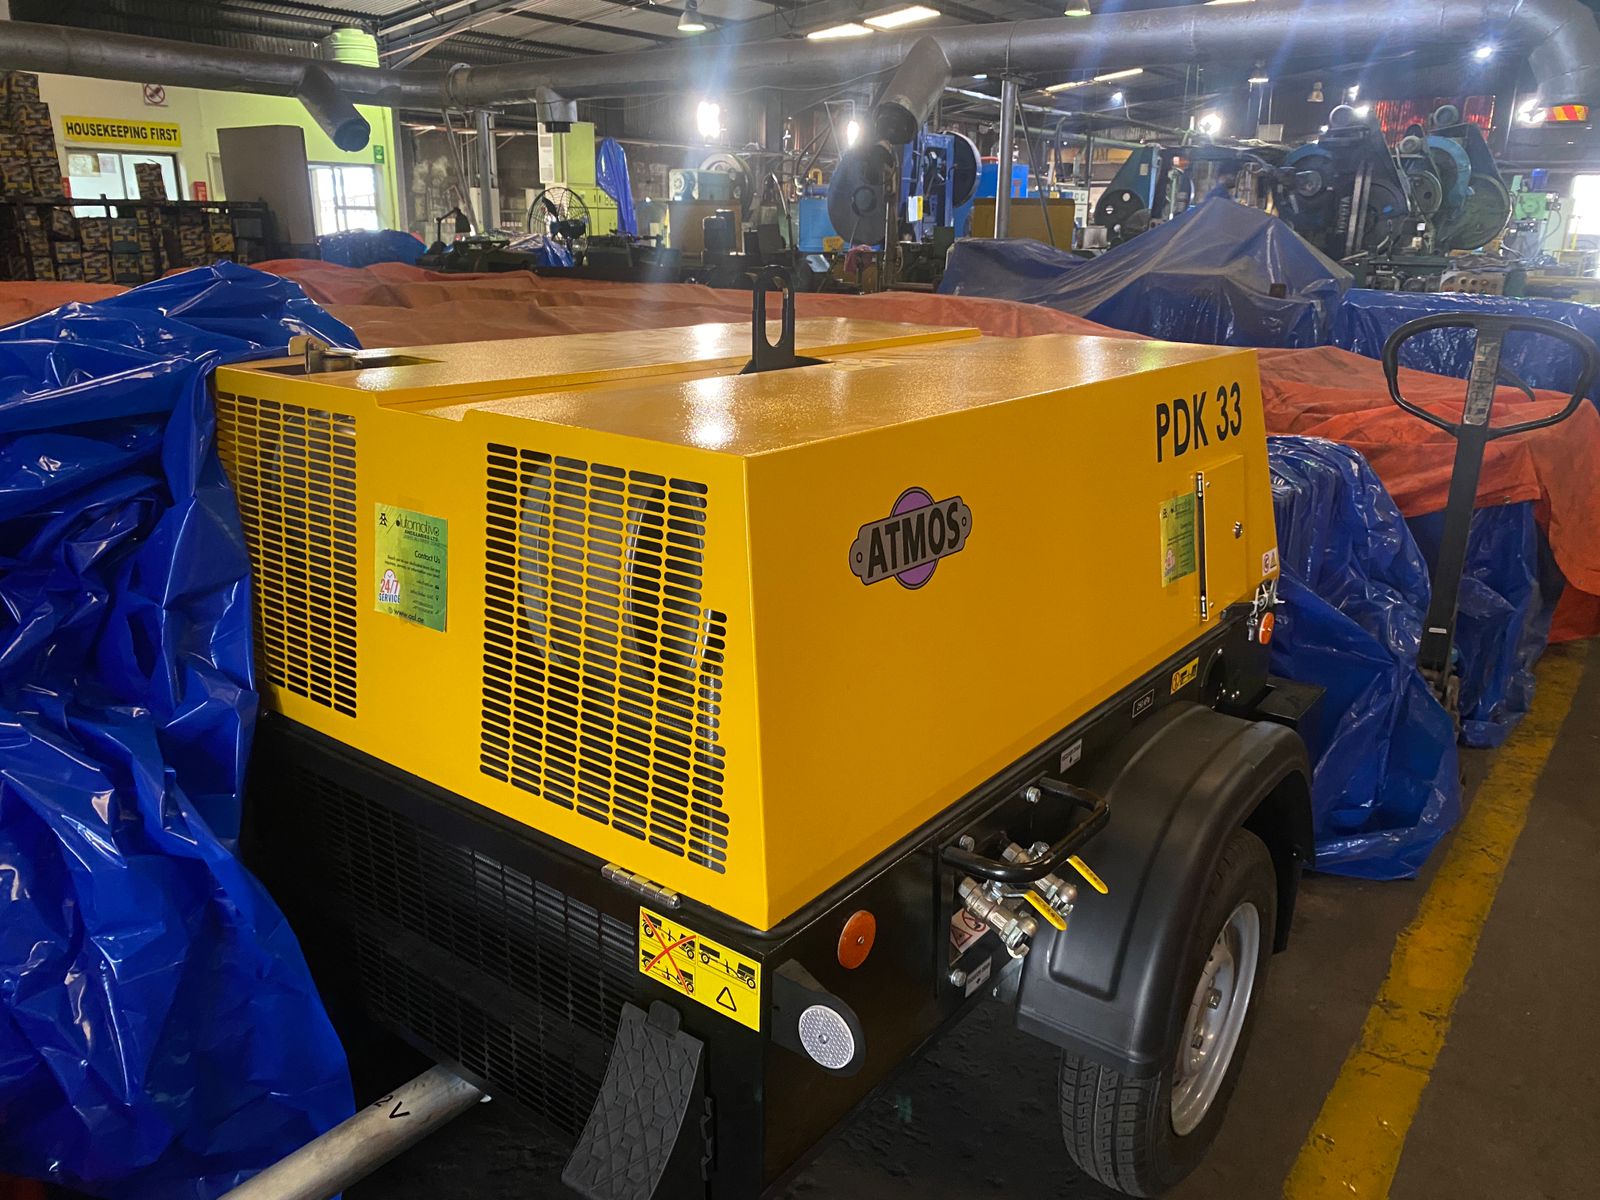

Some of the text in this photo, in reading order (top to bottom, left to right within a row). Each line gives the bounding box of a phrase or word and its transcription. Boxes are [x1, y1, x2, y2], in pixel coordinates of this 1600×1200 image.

[66, 122, 178, 141] HOUSEKEEPING FIRST
[1155, 381, 1243, 463] PDK 33
[867, 501, 961, 579] ATMOS
[380, 578, 400, 595] 24/7
[378, 592, 401, 603] SERVICE
